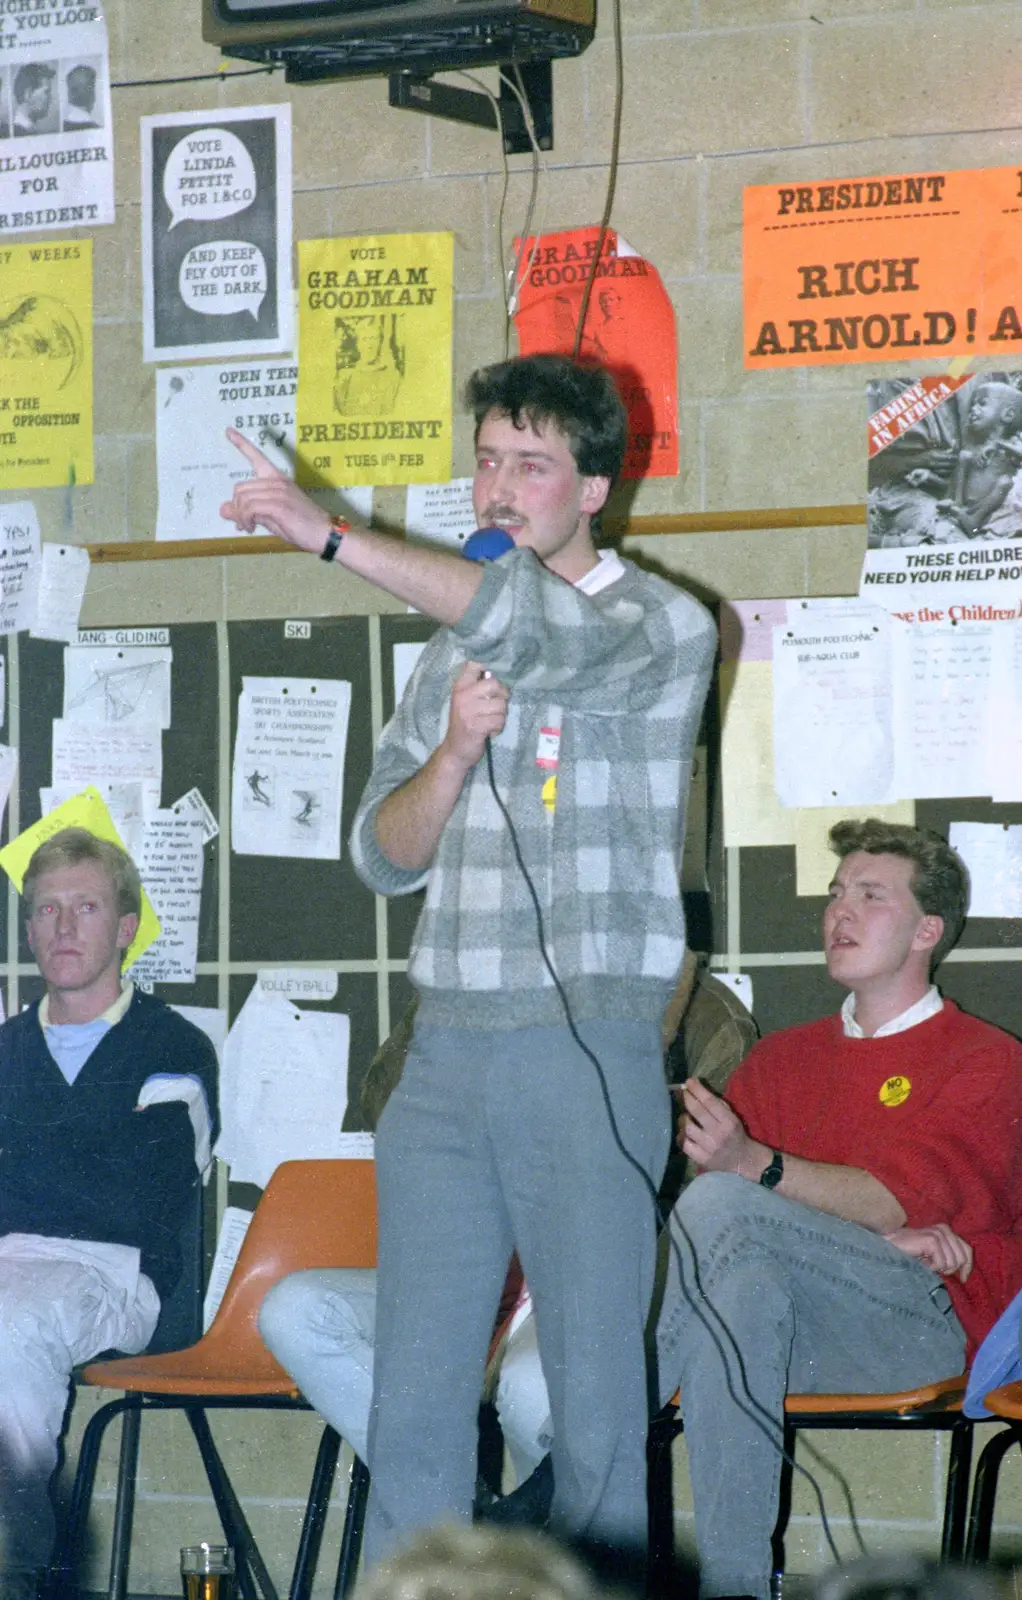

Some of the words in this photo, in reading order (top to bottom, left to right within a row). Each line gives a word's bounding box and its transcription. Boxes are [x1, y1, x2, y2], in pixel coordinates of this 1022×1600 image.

[15, 12, 51, 30] YOU
[54, 7, 98, 26] LOOK
[187, 139, 222, 153] VOTE
[184, 155, 236, 171] LINDA
[20, 176, 59, 195] FOR
[179, 173, 233, 190] PETTIT
[181, 192, 207, 206] FOR
[777, 176, 945, 215] PRESIDENT
[0, 203, 98, 230] RESIDENT
[29, 246, 81, 262] WEEKS
[188, 249, 217, 263] AND
[222, 247, 257, 260] KEEP
[350, 247, 387, 260] VOTE
[527, 239, 617, 266] GRAHA
[210, 265, 238, 278] OUT
[241, 263, 258, 277] OF
[307, 267, 429, 289] GRAHAM
[529, 257, 649, 288] GOODMAN
[797, 257, 920, 300] RICH
[192, 283, 218, 297] THE
[308, 288, 437, 310] GOODMAN
[749, 308, 977, 357] ARNOLD!
[219, 369, 261, 384] OPEN
[14, 397, 40, 411] THE
[868, 384, 927, 432] FAMINE
[12, 412, 81, 428] OPPOSITION
[235, 412, 294, 428] SINGL
[872, 427, 893, 448] IN
[895, 382, 952, 431] AFRICA
[299, 420, 442, 444] PRESIDENT
[313, 456, 331, 469] ON
[345, 454, 379, 468] TUES
[399, 453, 424, 467] FEB
[906, 553, 954, 567] THESE
[864, 572, 907, 585] NEED
[910, 570, 952, 584] YOUR
[955, 568, 995, 582] HELP
[998, 566, 1022, 580] NO
[918, 607, 944, 622] the
[948, 604, 1016, 621] Children
[287, 624, 308, 637] SKI
[260, 980, 334, 993] VOLLEYBALL
[886, 1077, 903, 1090] NO
